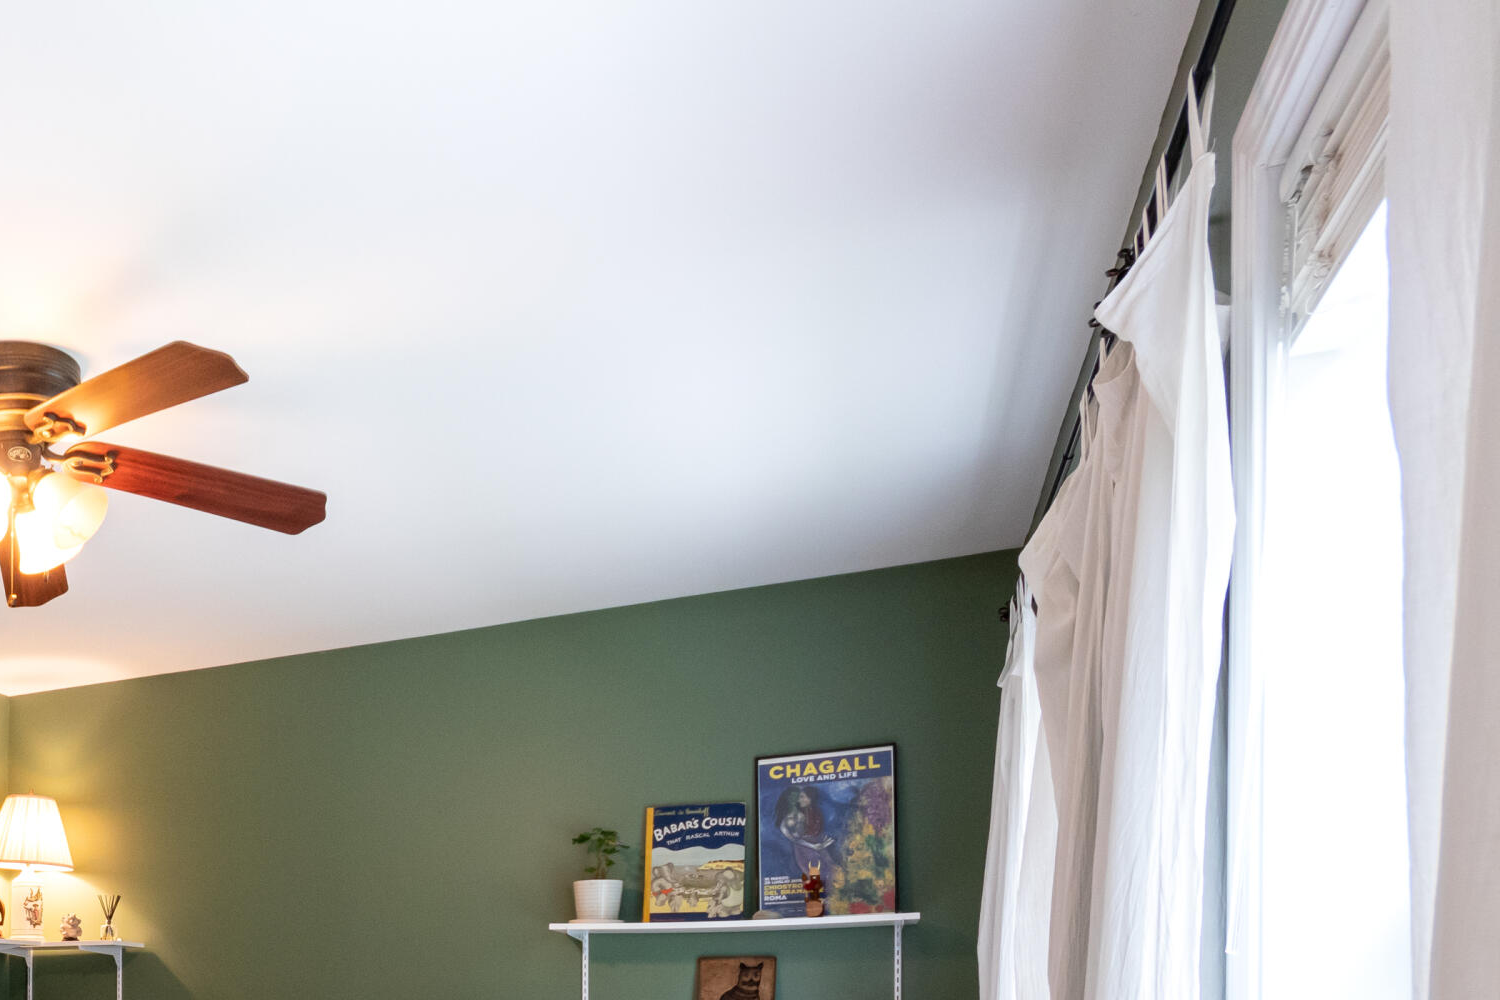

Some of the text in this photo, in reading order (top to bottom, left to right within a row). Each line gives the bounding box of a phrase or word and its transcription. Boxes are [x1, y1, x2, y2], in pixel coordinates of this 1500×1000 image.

[769, 755, 881, 779] CHAGALL
[791, 770, 858, 784] LOVE AND LIFE
[653, 816, 746, 842] BABAR'S COUSIN
[666, 837, 682, 846] THAT
[685, 832, 710, 841] RASCAL
